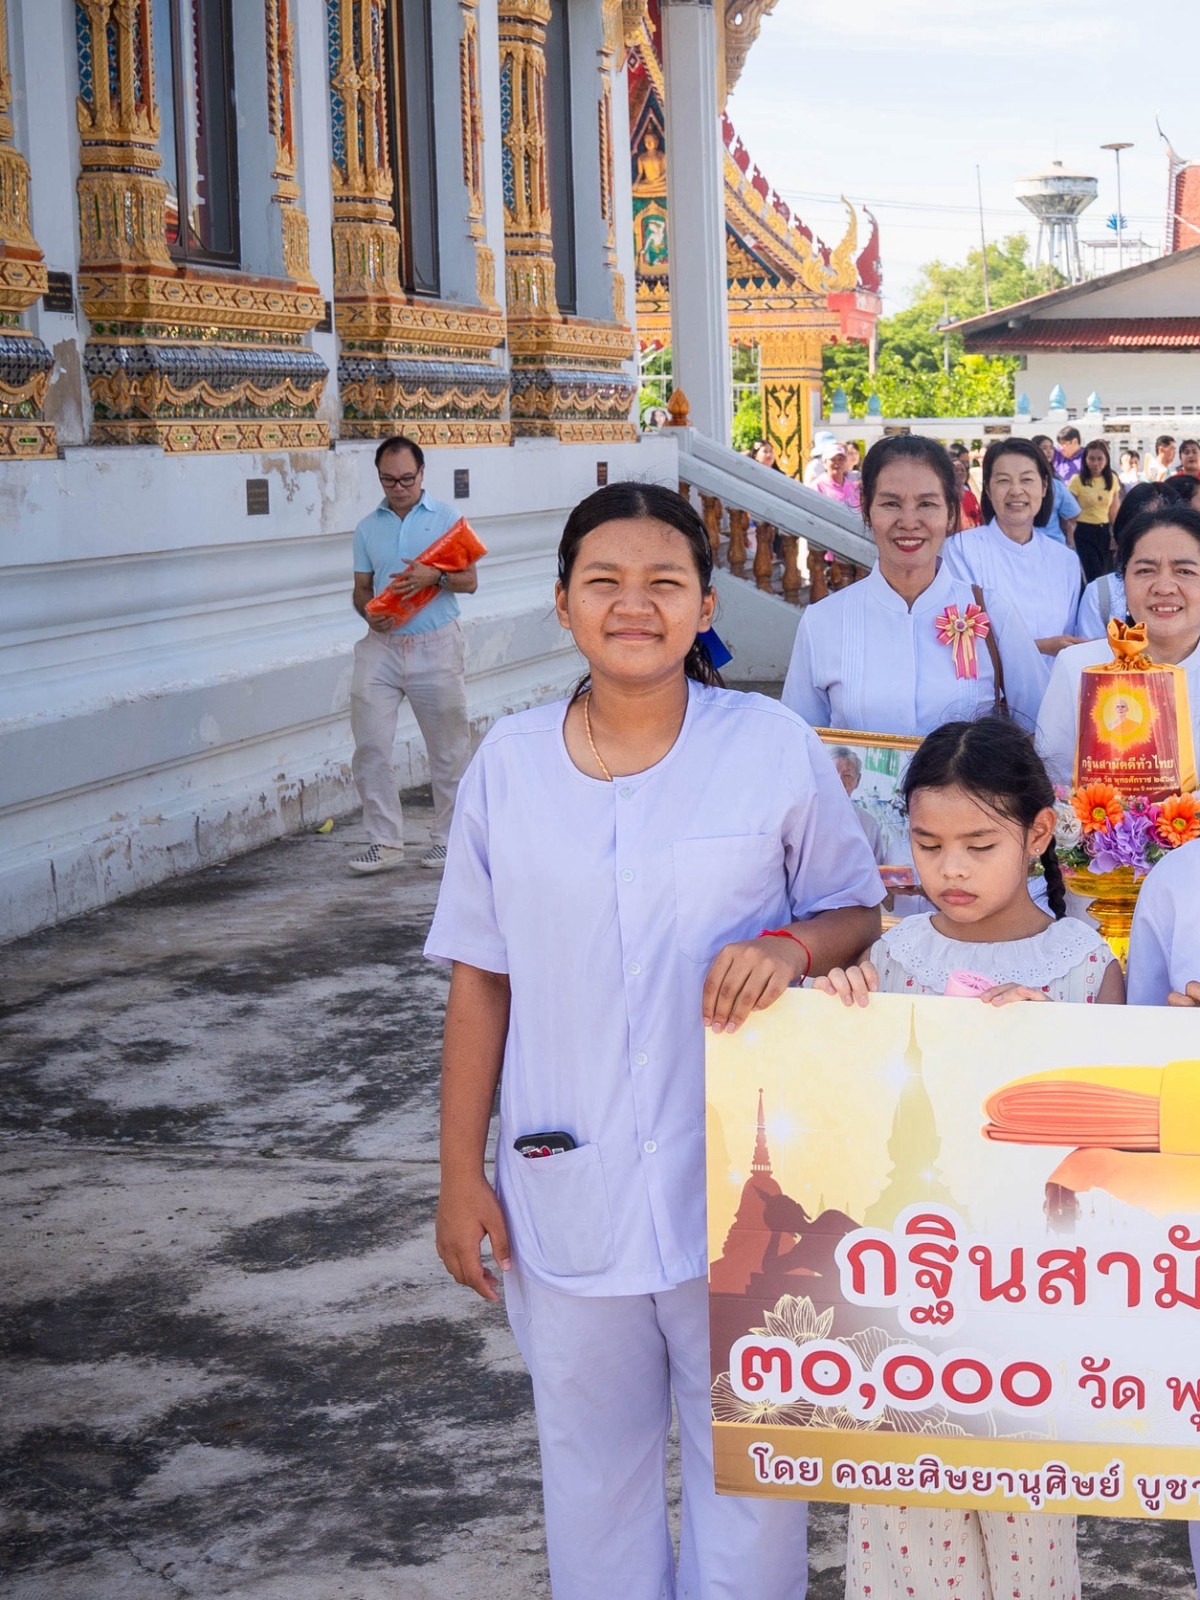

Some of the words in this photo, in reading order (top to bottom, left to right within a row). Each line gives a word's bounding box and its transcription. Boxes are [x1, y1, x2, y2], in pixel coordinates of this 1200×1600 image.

[741, 1345, 1052, 1410] ๓๐,๐๐๐
[1078, 1356, 1145, 1410] วัด
[752, 1446, 818, 1482] โดย
[835, 1458, 1120, 1505] คณะศิษยานุศิษย์
